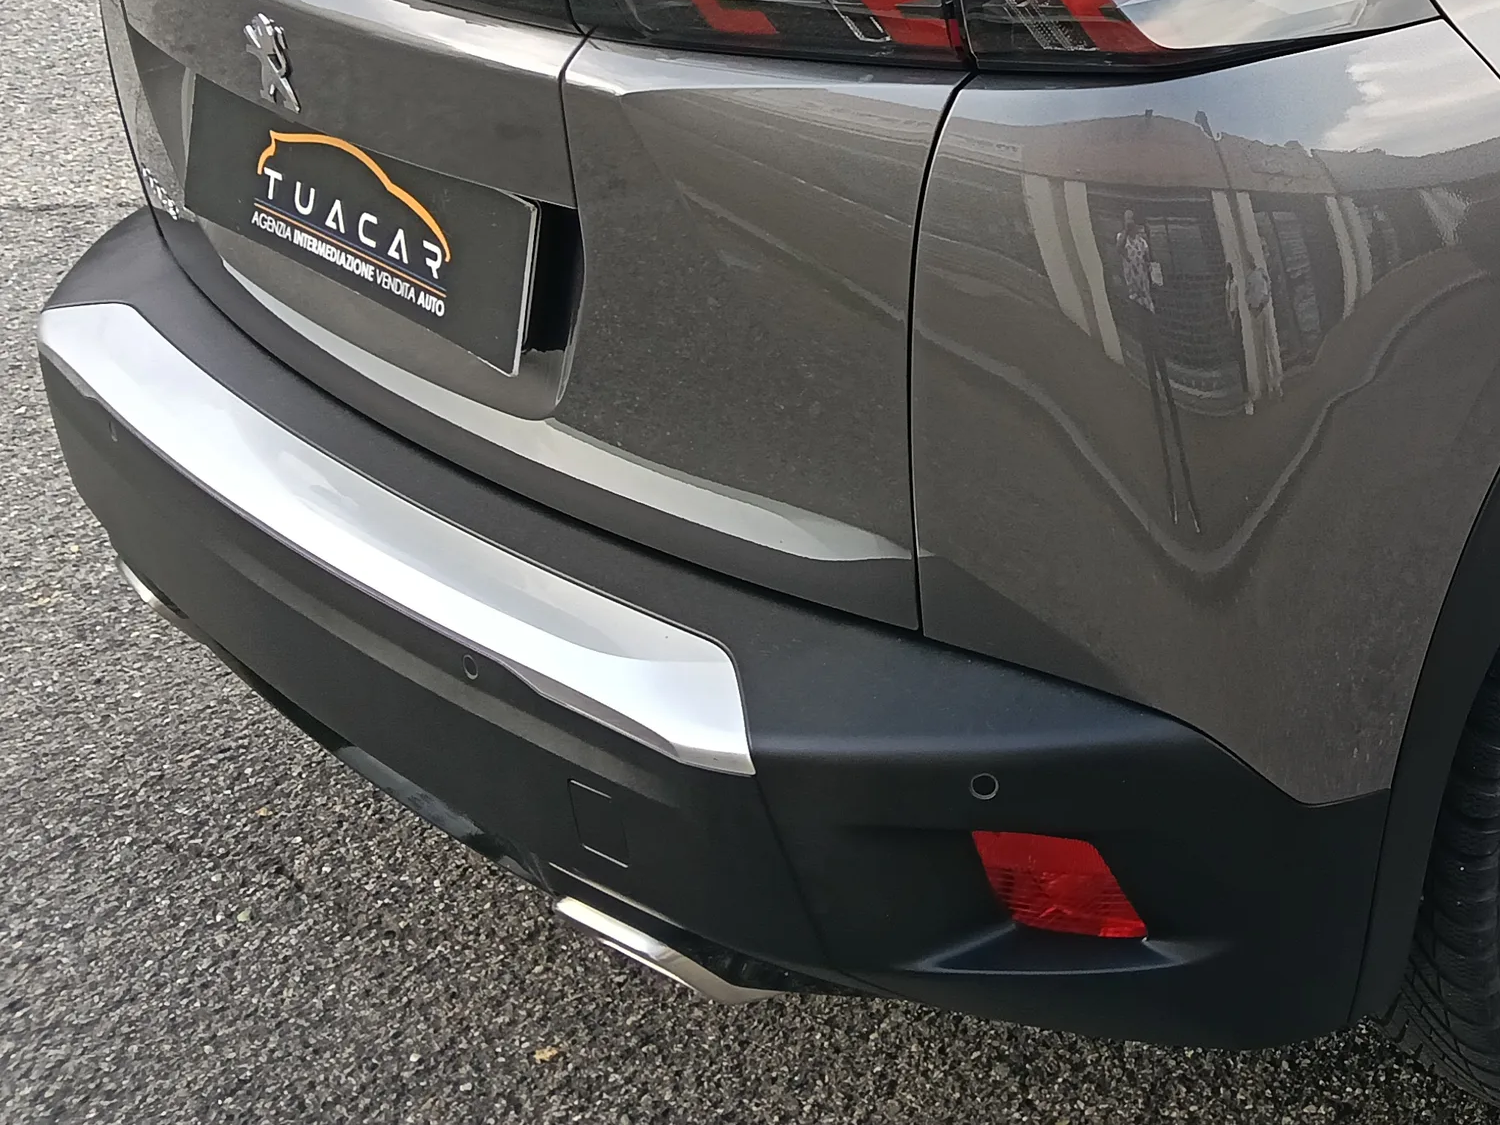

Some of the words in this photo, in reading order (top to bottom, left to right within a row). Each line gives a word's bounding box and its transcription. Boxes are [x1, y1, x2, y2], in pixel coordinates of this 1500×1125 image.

[251, 210, 292, 243] AGENZIA
[293, 229, 375, 282] INTERMEDIAZIONE
[376, 268, 416, 304] VENDITA
[416, 290, 446, 317] AUTO
[263, 166, 443, 280] TUACAR
